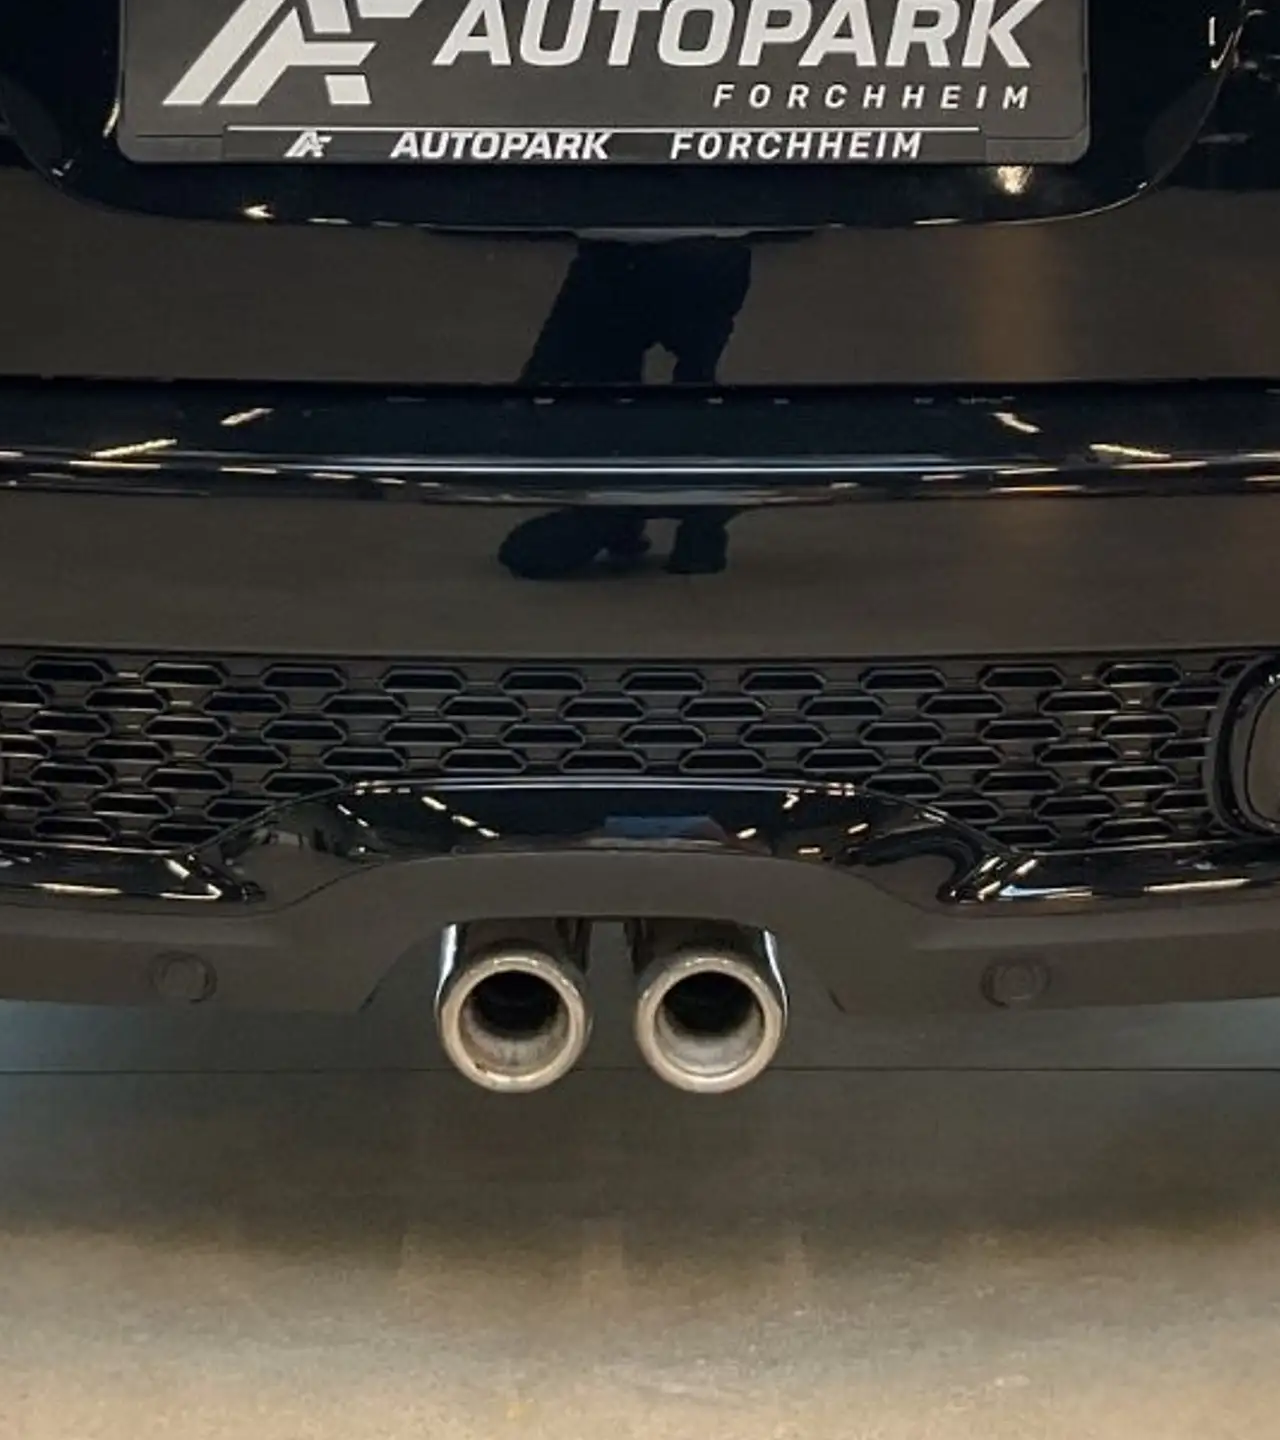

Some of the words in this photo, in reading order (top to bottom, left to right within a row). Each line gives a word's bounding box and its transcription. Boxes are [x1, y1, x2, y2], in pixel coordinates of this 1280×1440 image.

[712, 83, 1030, 110] FORCHHEIM
[391, 131, 614, 160] AUTOPARK
[669, 131, 922, 160] FORCHHEIM
